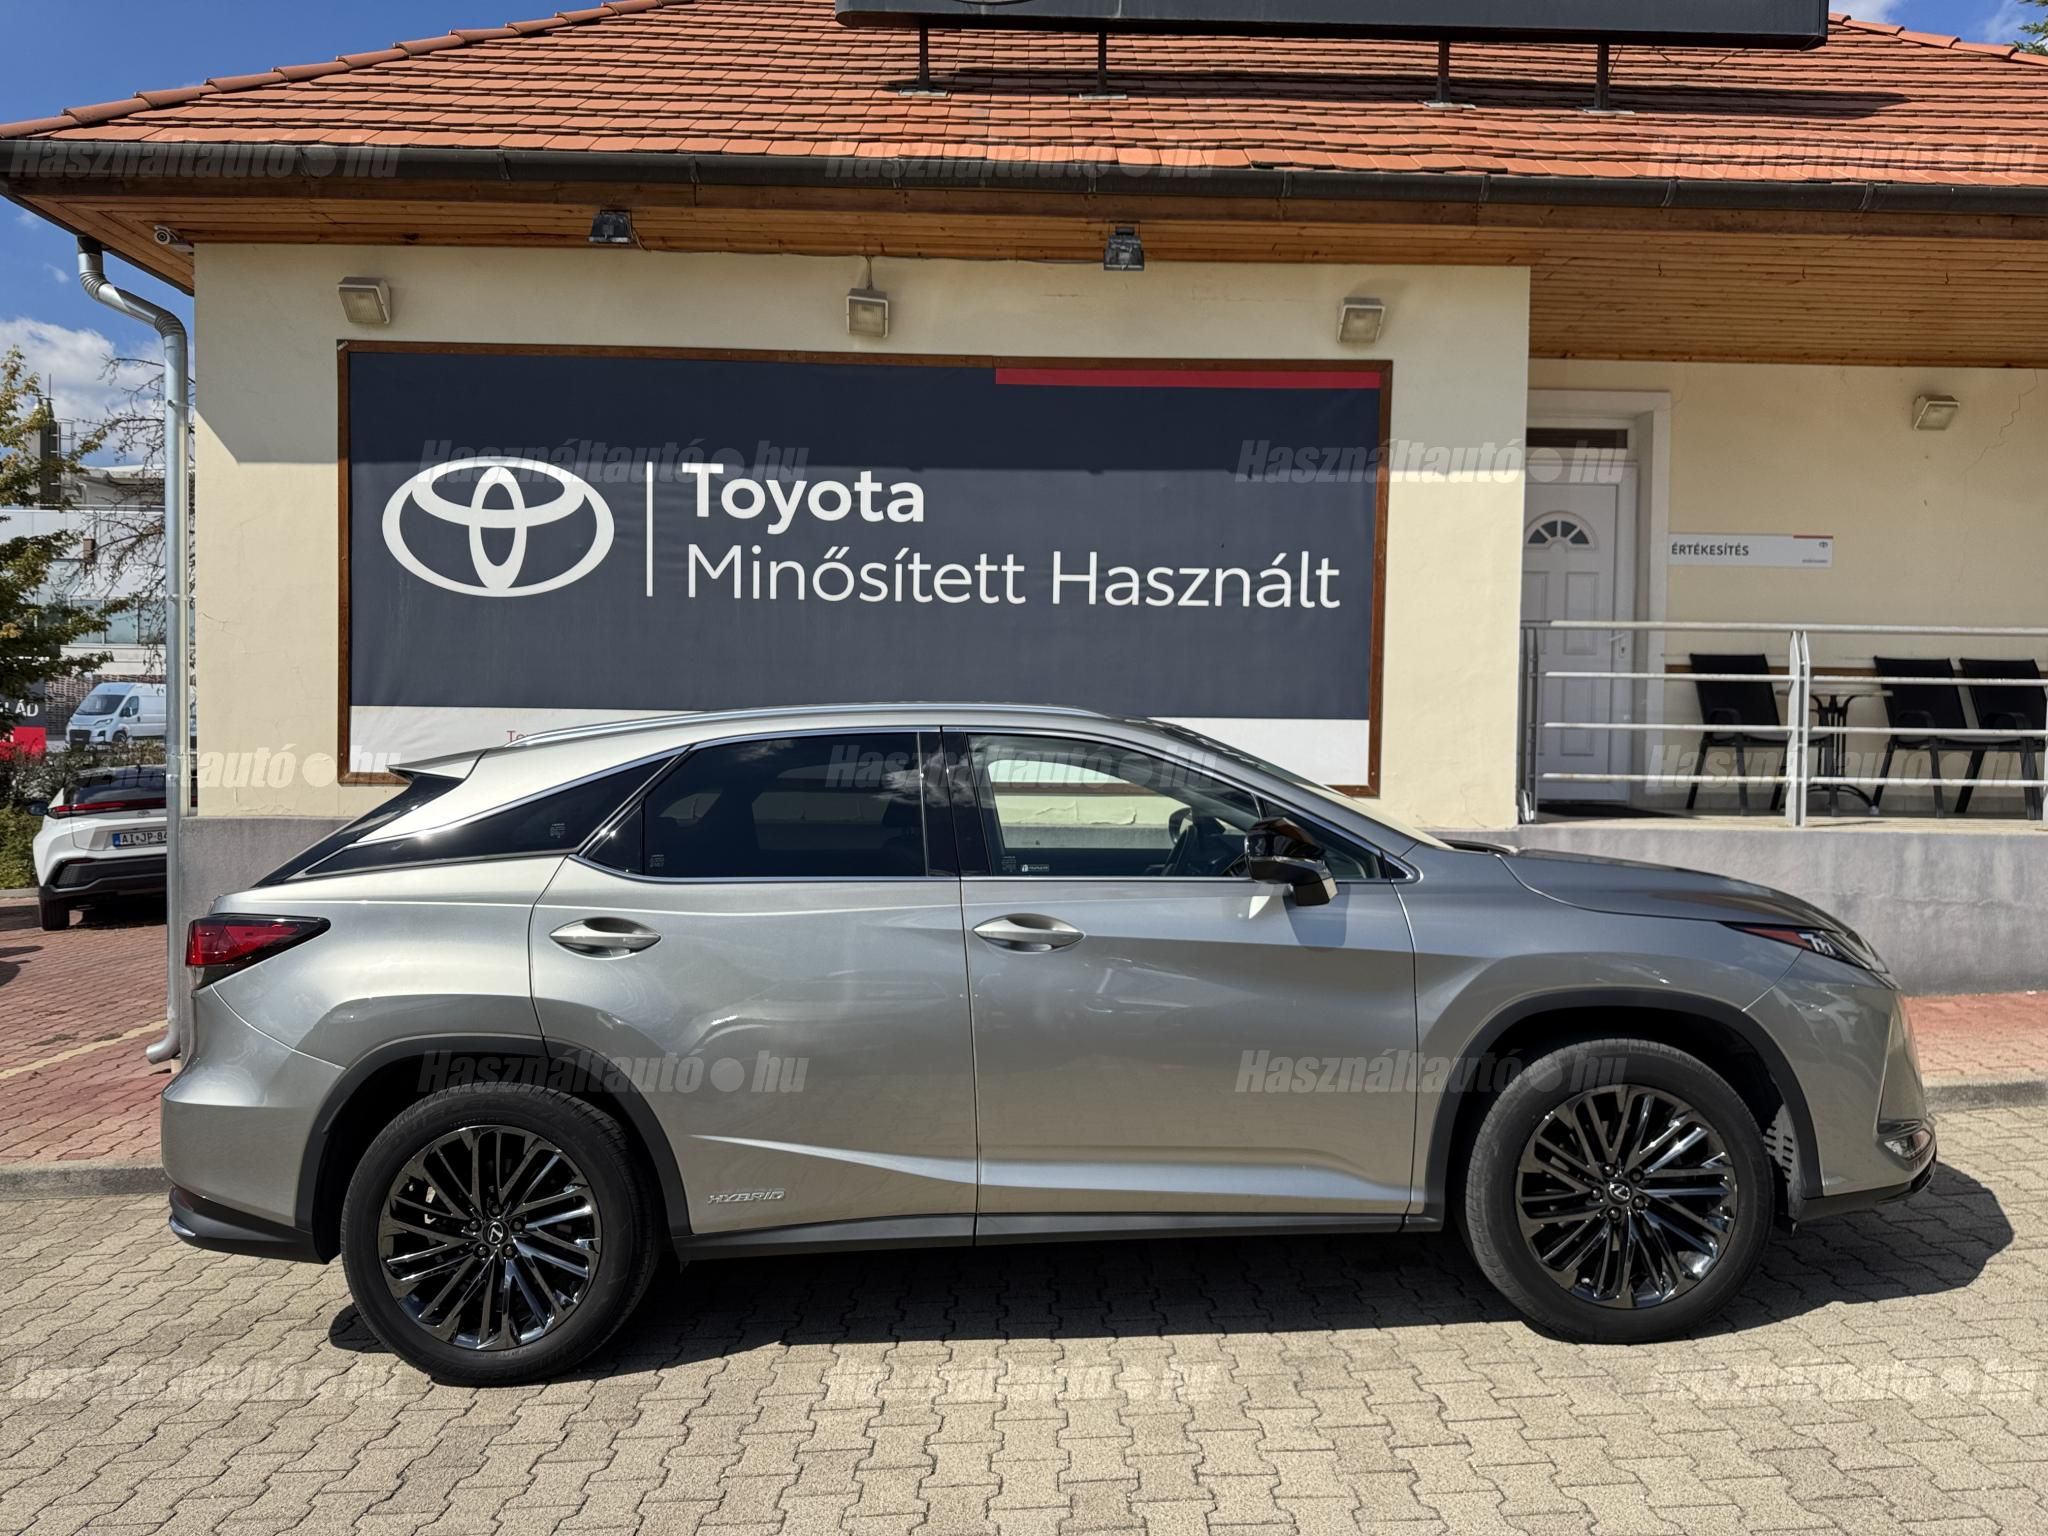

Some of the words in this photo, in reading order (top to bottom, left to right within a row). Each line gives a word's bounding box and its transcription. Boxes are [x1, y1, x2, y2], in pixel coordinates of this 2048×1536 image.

[682, 462, 925, 535] Toyota
[1671, 541, 1749, 556] ÉRTÉKESÍTÉS
[686, 543, 1026, 605] Minősített
[1051, 549, 1342, 610] Használt
[707, 1190, 785, 1204] HYBRID
